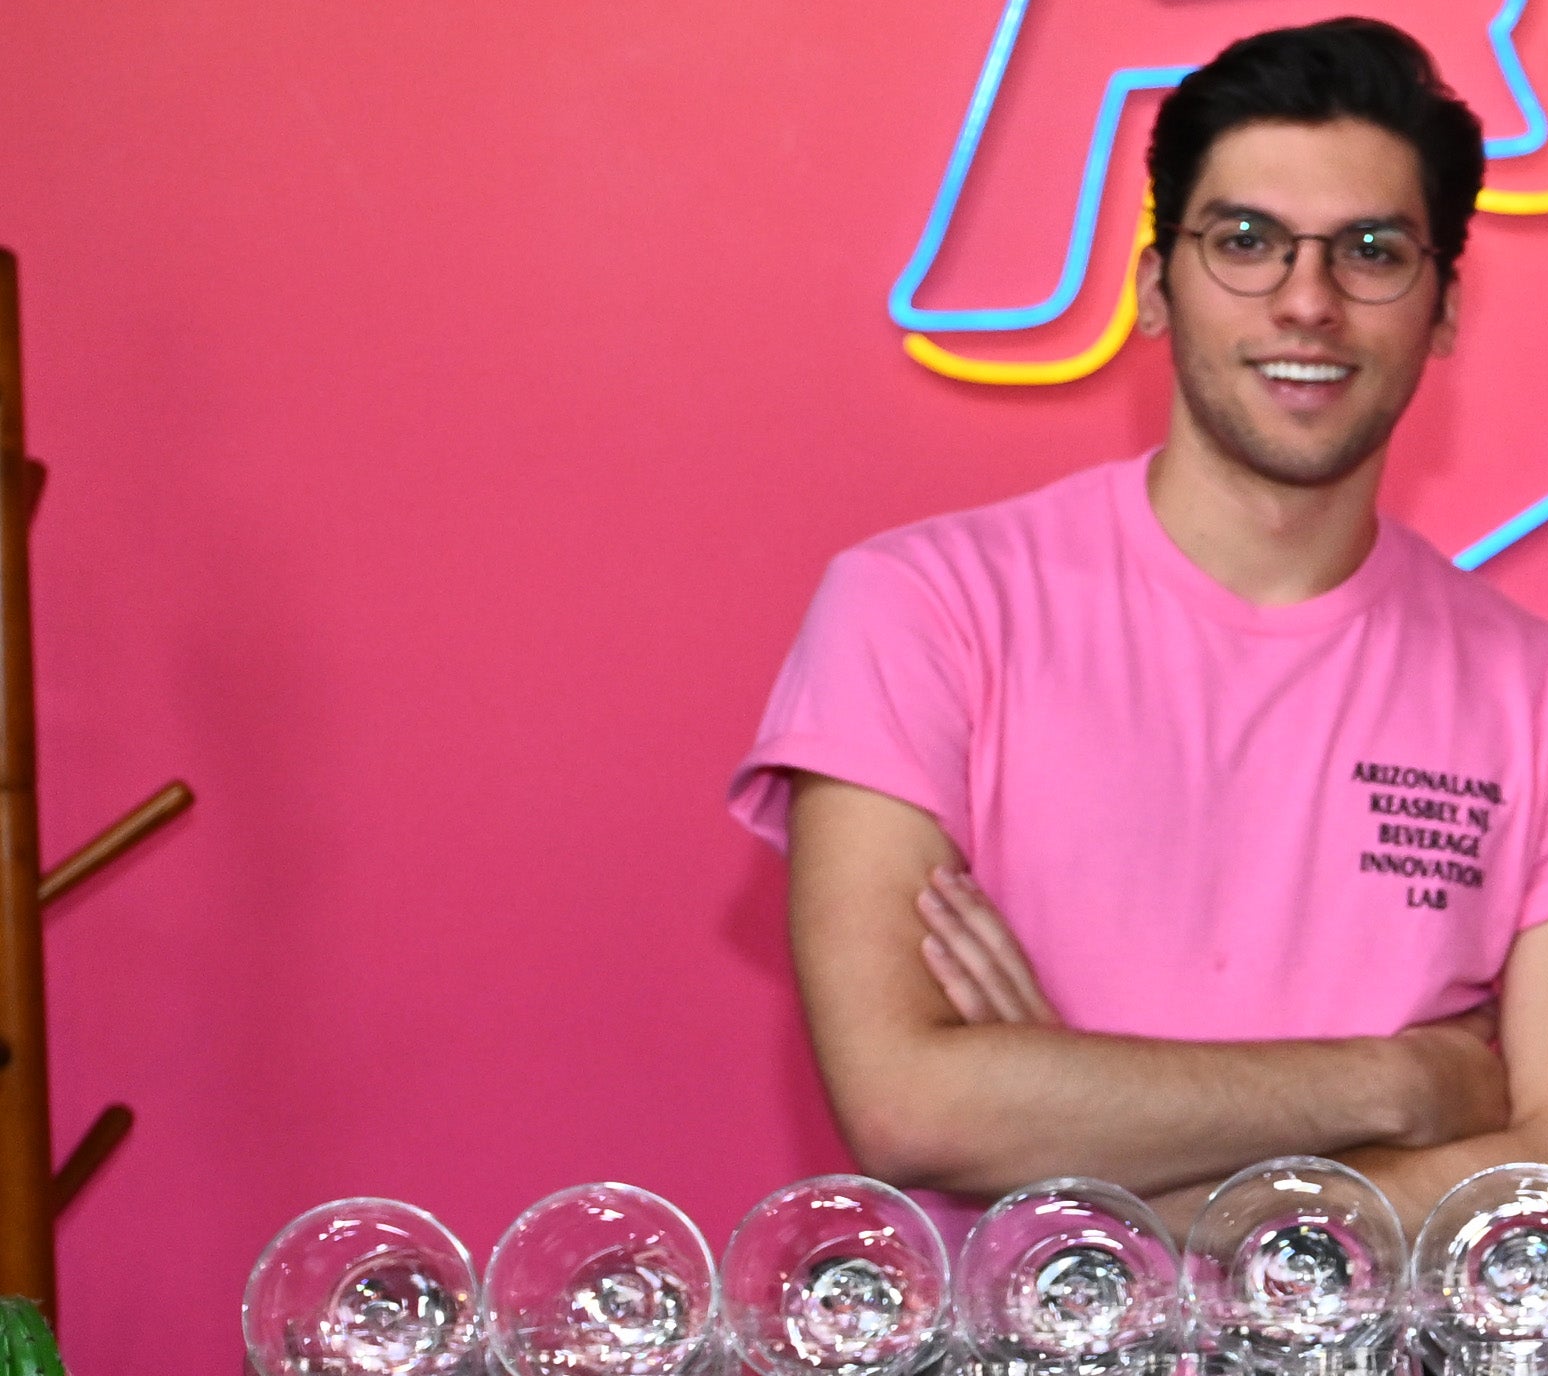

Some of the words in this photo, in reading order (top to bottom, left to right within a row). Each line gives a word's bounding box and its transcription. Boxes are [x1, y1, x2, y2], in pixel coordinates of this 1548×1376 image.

[1378, 823, 1480, 858] BEVERAGE
[1360, 852, 1483, 888] INNOVATION
[1407, 887, 1448, 910] LAB
